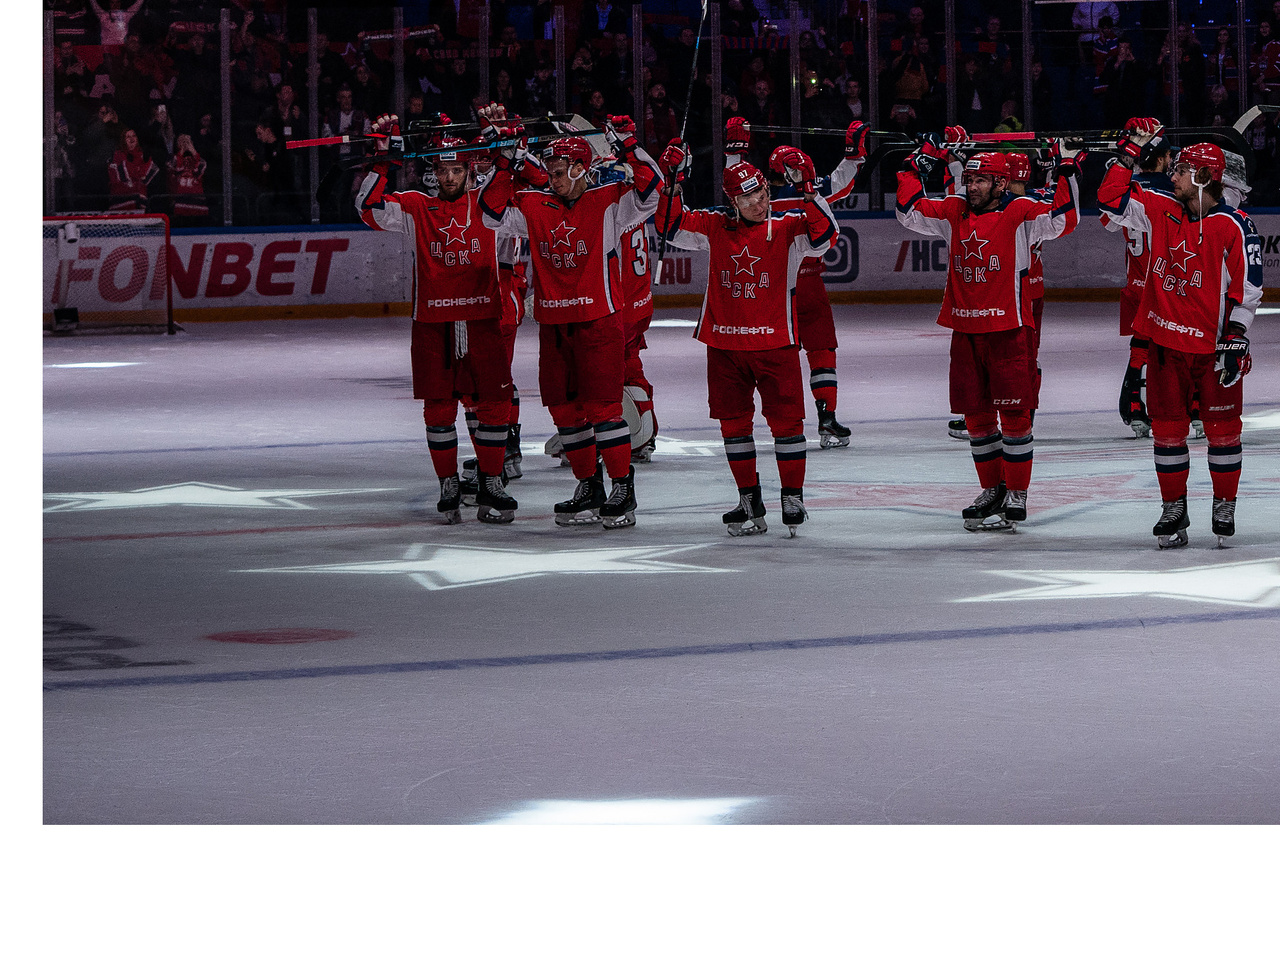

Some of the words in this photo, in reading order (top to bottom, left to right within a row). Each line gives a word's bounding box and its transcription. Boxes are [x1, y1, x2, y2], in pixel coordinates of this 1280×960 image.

[738, 168, 749, 180] 97
[1017, 169, 1028, 178] 37
[430, 238, 482, 267] ЦСКА
[540, 240, 588, 269] ЦСКА
[1247, 243, 1262, 267] 23
[51, 238, 350, 304] FONBET
[953, 254, 1001, 283] ЦСКА
[1152, 256, 1203, 297] ЦСКА
[720, 270, 770, 299] ЦСКА
[427, 295, 491, 308] РОСНЕФТЬ
[951, 307, 1006, 318] РОСНЕФТЬ
[712, 324, 775, 336] РОСНЕФТЬ
[993, 398, 1022, 406] CCM
